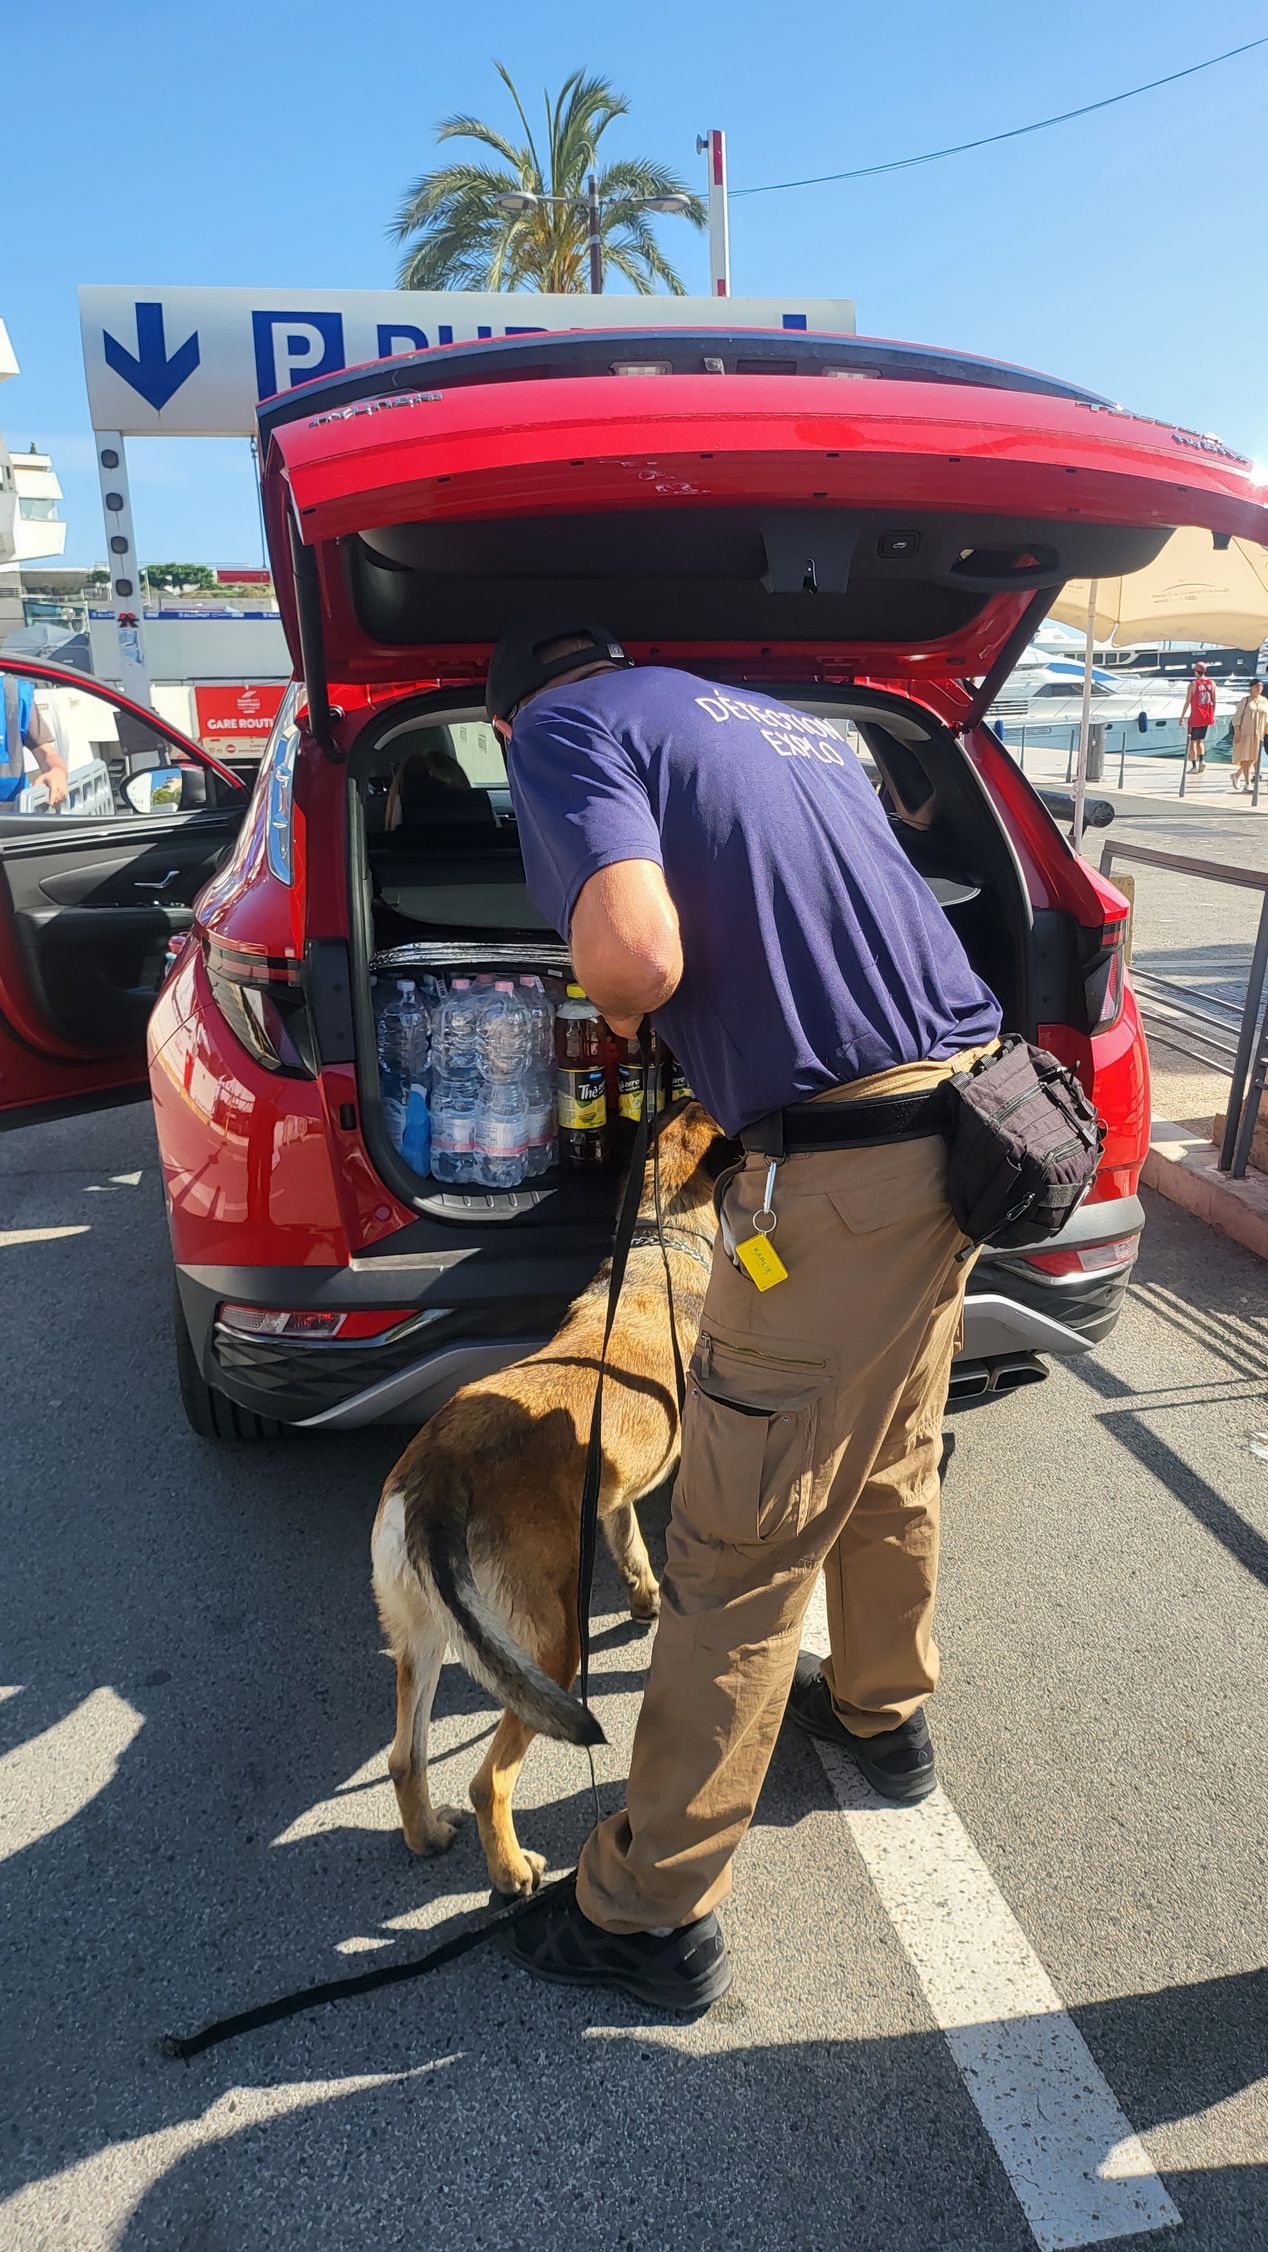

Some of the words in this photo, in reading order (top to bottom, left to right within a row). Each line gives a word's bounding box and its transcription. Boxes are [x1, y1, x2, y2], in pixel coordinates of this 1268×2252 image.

[207, 718, 238, 730] GARE
[239, 717, 274, 729] ROUTI
[694, 689, 845, 742] DÉTECTION
[760, 729, 845, 766] EXPLO
[577, 1083, 598, 1100] Thè
[752, 1247, 773, 1274] KARLIE
